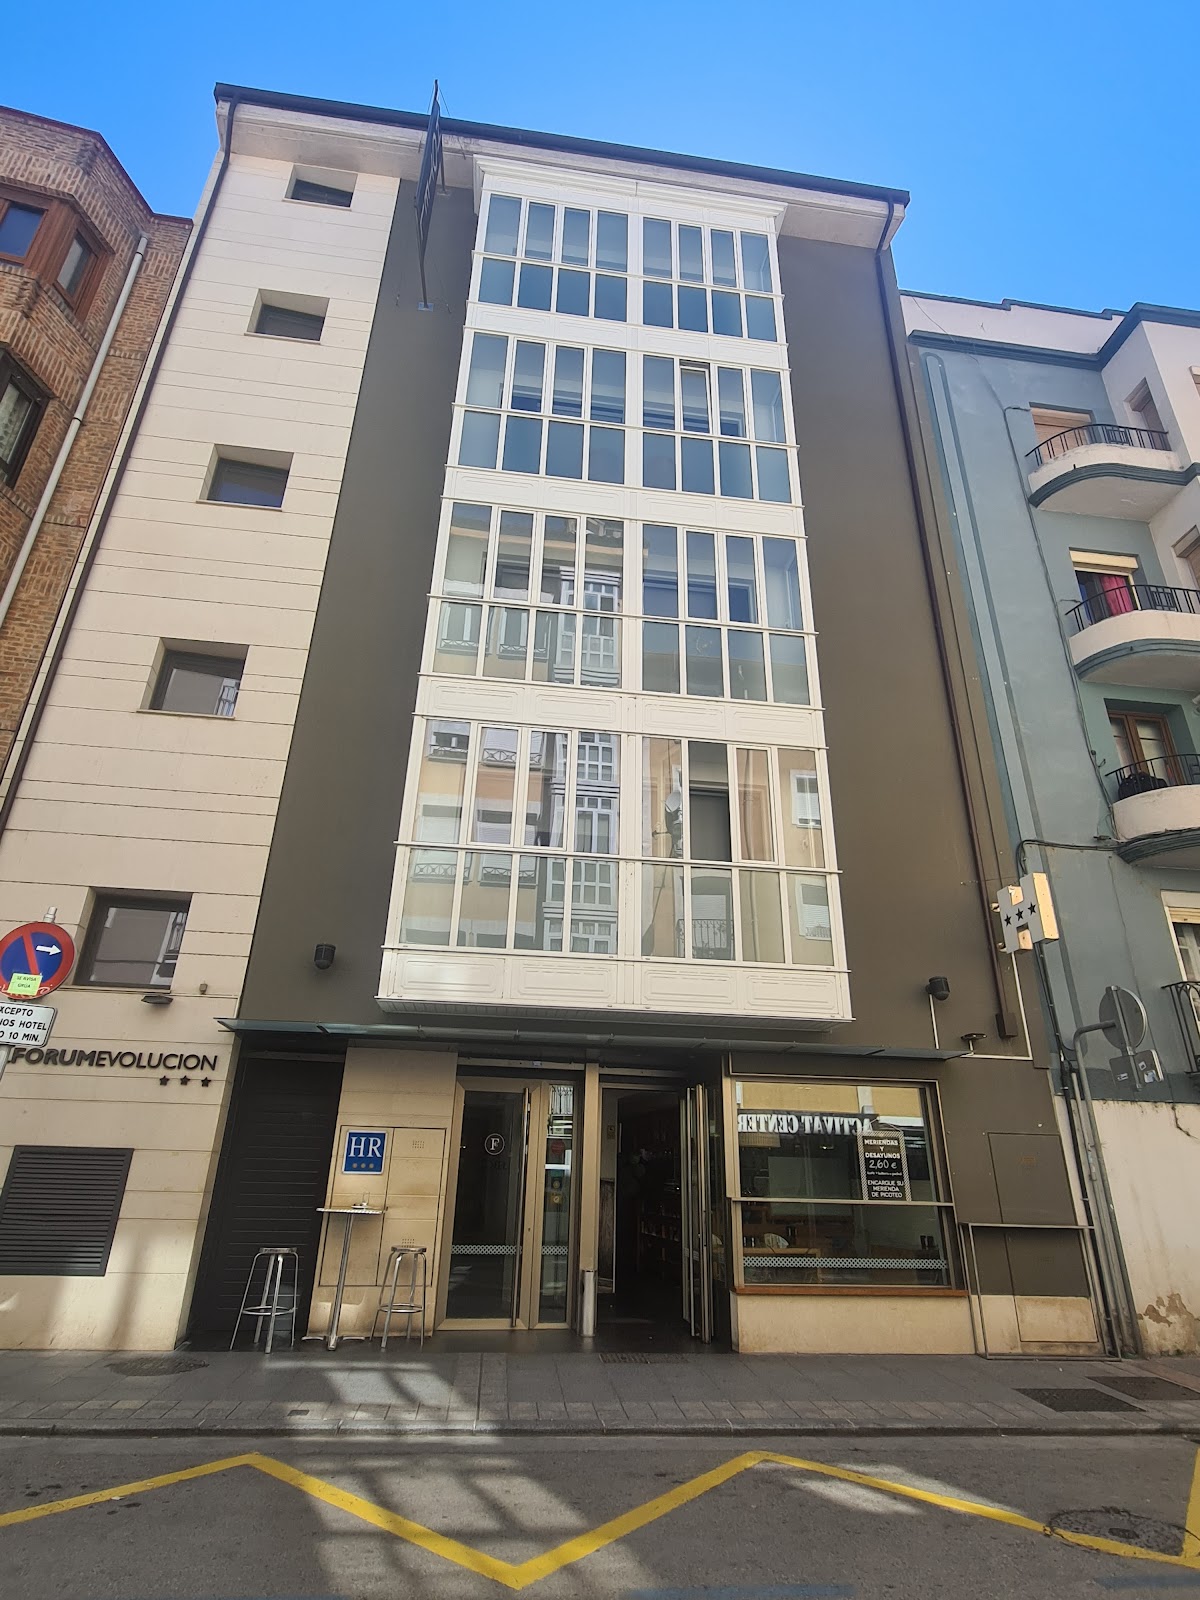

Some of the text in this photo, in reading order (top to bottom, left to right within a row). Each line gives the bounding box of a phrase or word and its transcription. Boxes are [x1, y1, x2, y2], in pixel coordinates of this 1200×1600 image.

[18, 1020, 47, 1031] HOTEL
[8, 1032, 19, 1040] 10
[22, 1033, 40, 1043] MIN.
[348, 1136, 382, 1158] HR
[868, 1159, 898, 1169] 2,60 €
